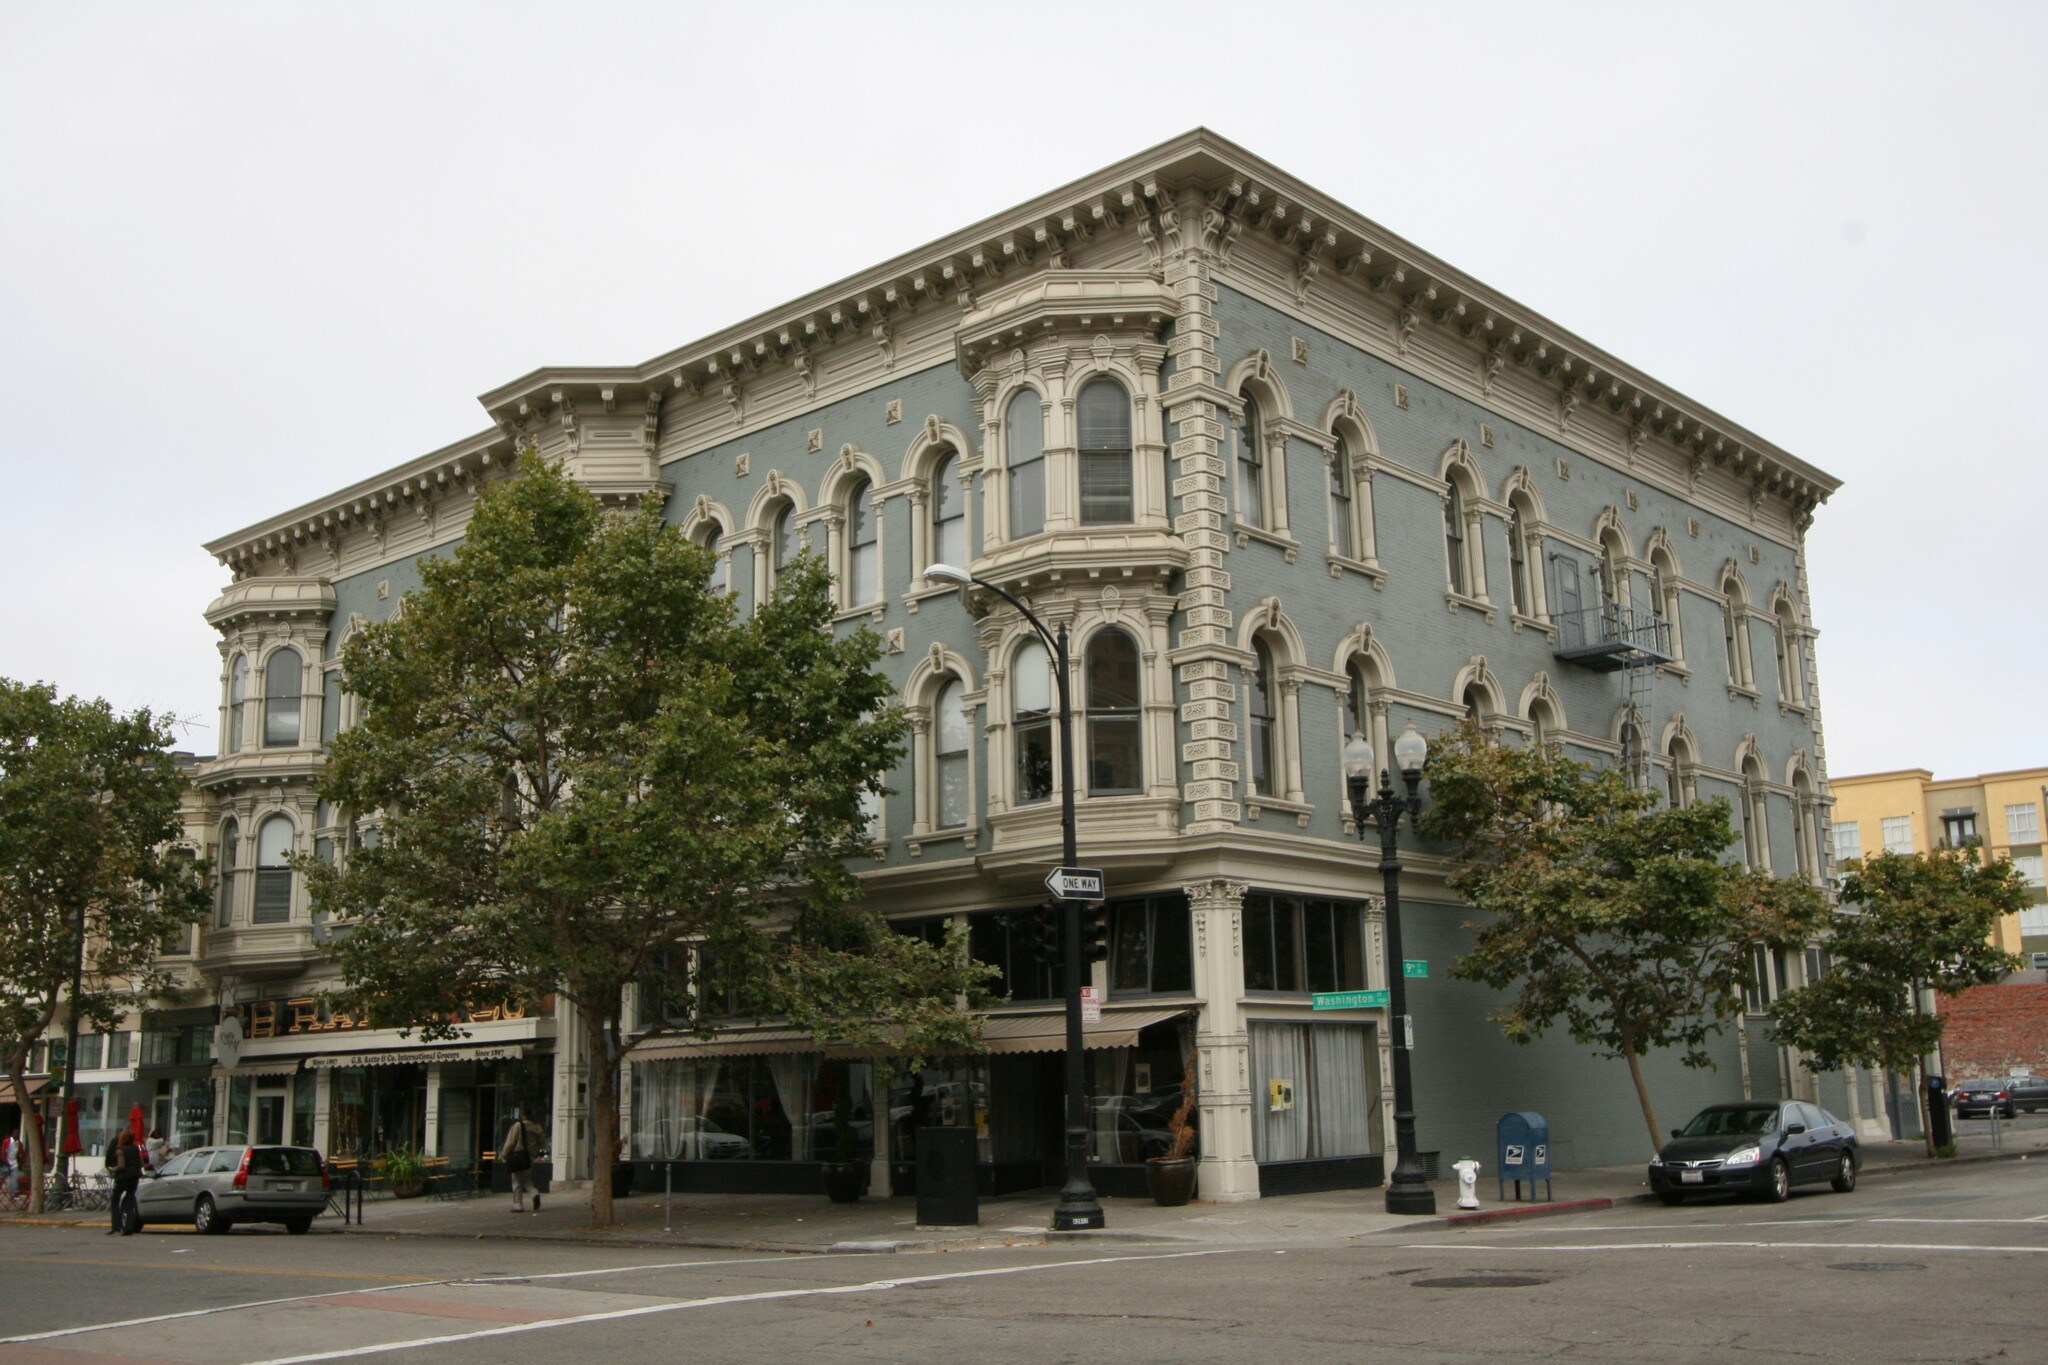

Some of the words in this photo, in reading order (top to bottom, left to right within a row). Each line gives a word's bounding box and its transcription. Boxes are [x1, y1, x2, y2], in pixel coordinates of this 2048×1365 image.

[1063, 878, 1078, 889] ONE
[1081, 879, 1097, 889] WAY
[1317, 995, 1374, 1006] Washington
[398, 1051, 436, 1061] International
[437, 1050, 460, 1060] Grocers
[475, 1049, 490, 1057] Since
